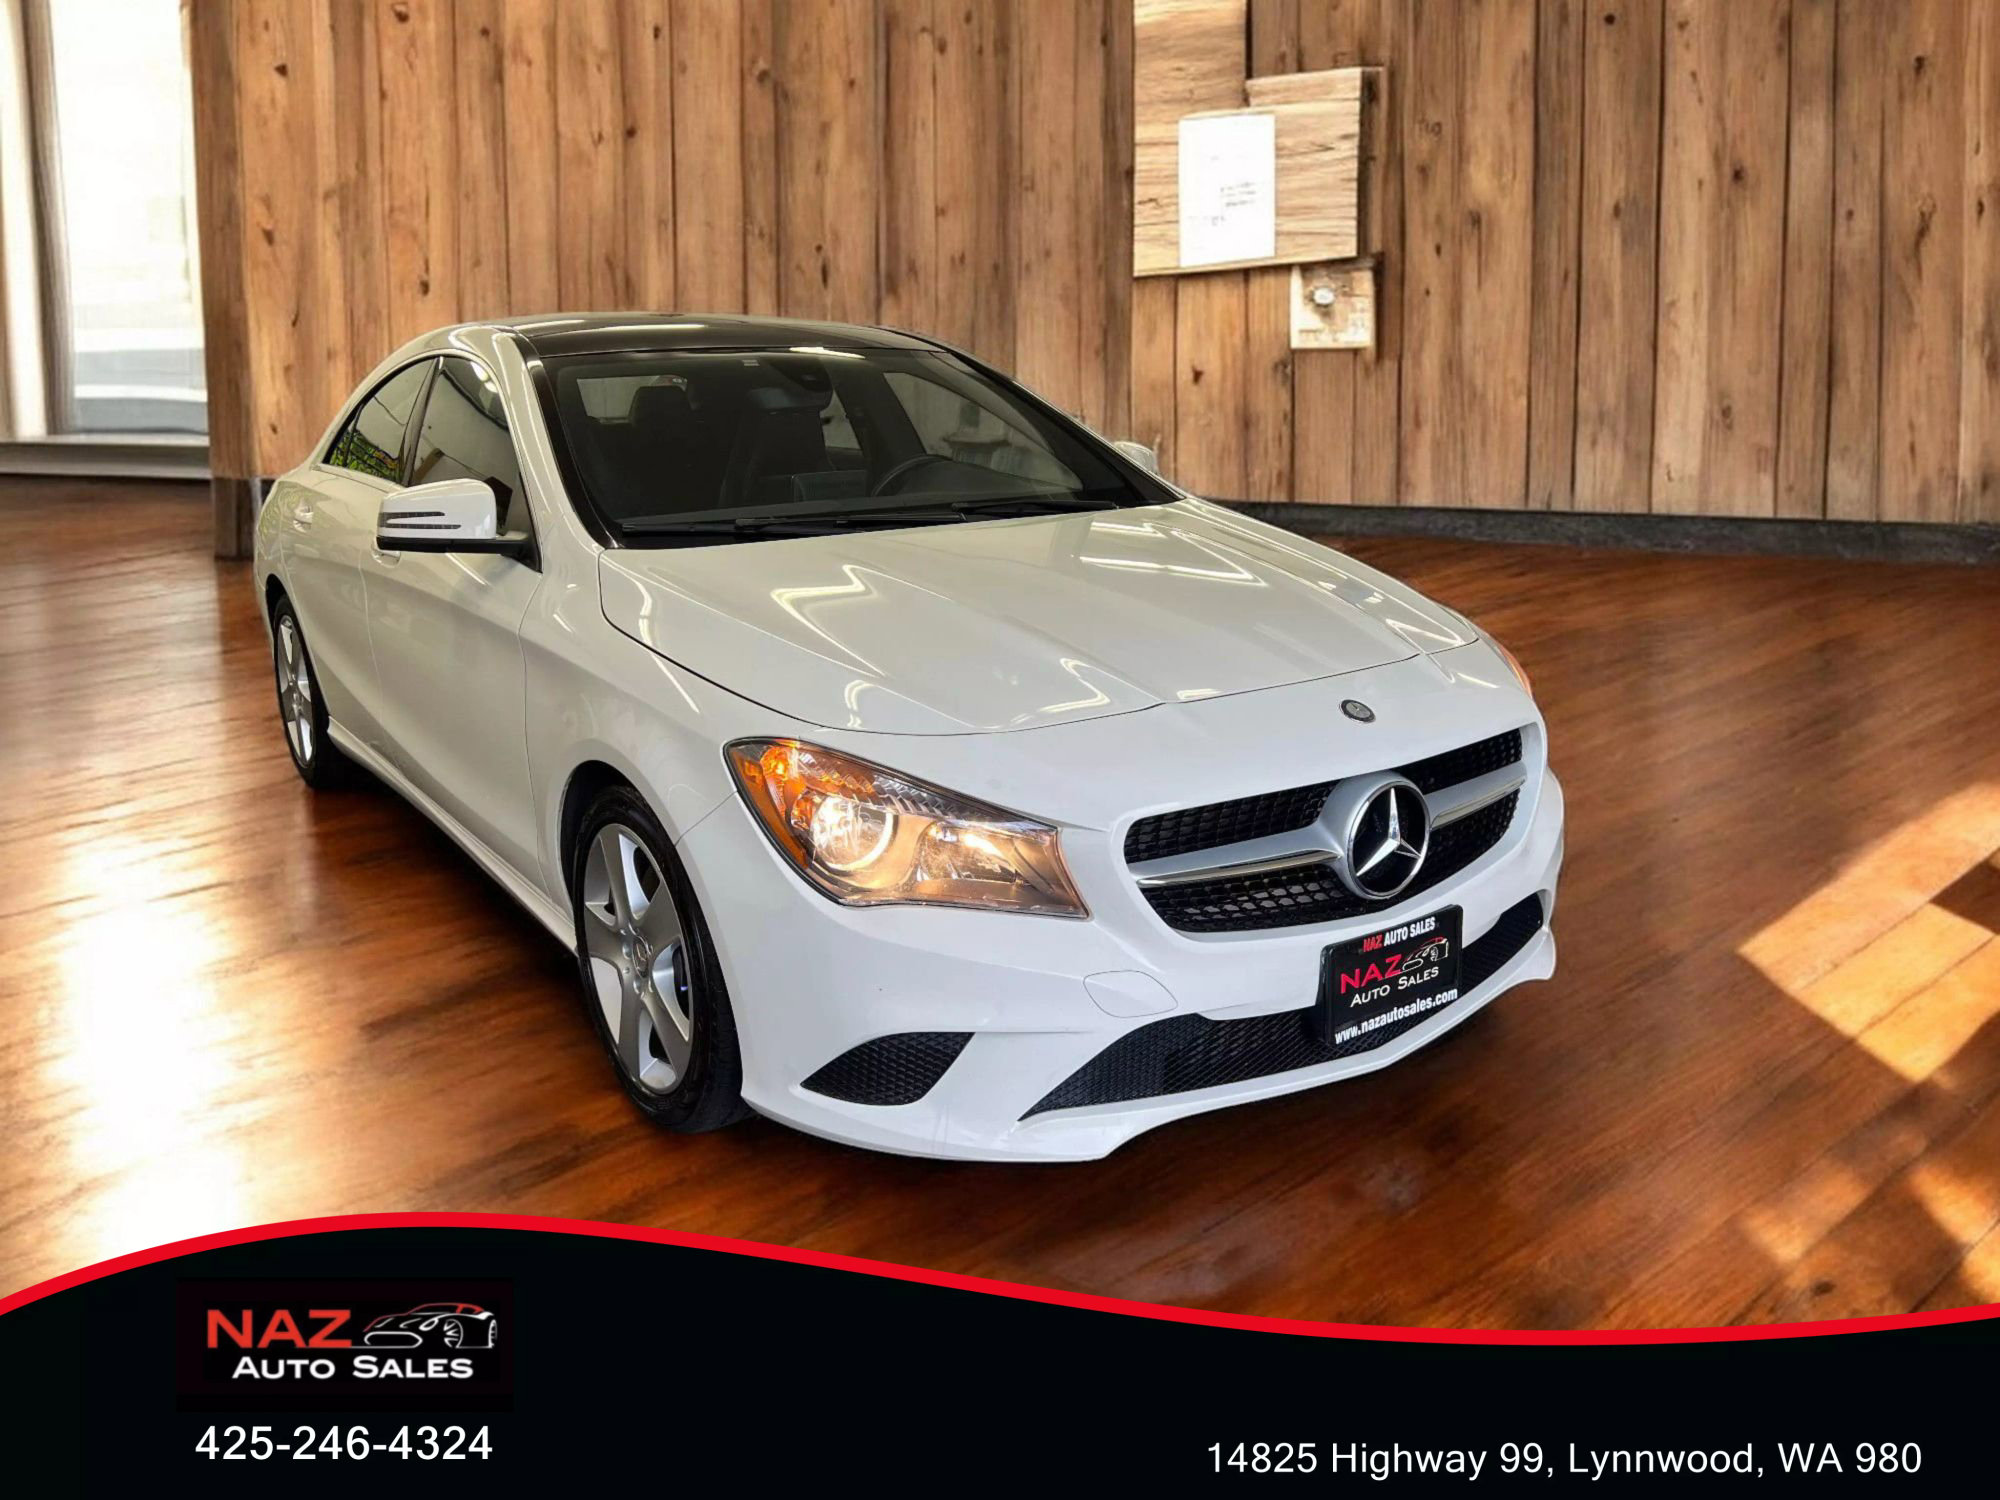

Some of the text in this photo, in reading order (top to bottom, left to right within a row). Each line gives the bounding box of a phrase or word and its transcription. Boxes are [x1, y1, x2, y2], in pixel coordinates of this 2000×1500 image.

[1362, 916, 1436, 953] NAZ AUTO SALES
[1340, 954, 1403, 995] NAZ
[1334, 988, 1458, 1045] www.nazautosales.com
